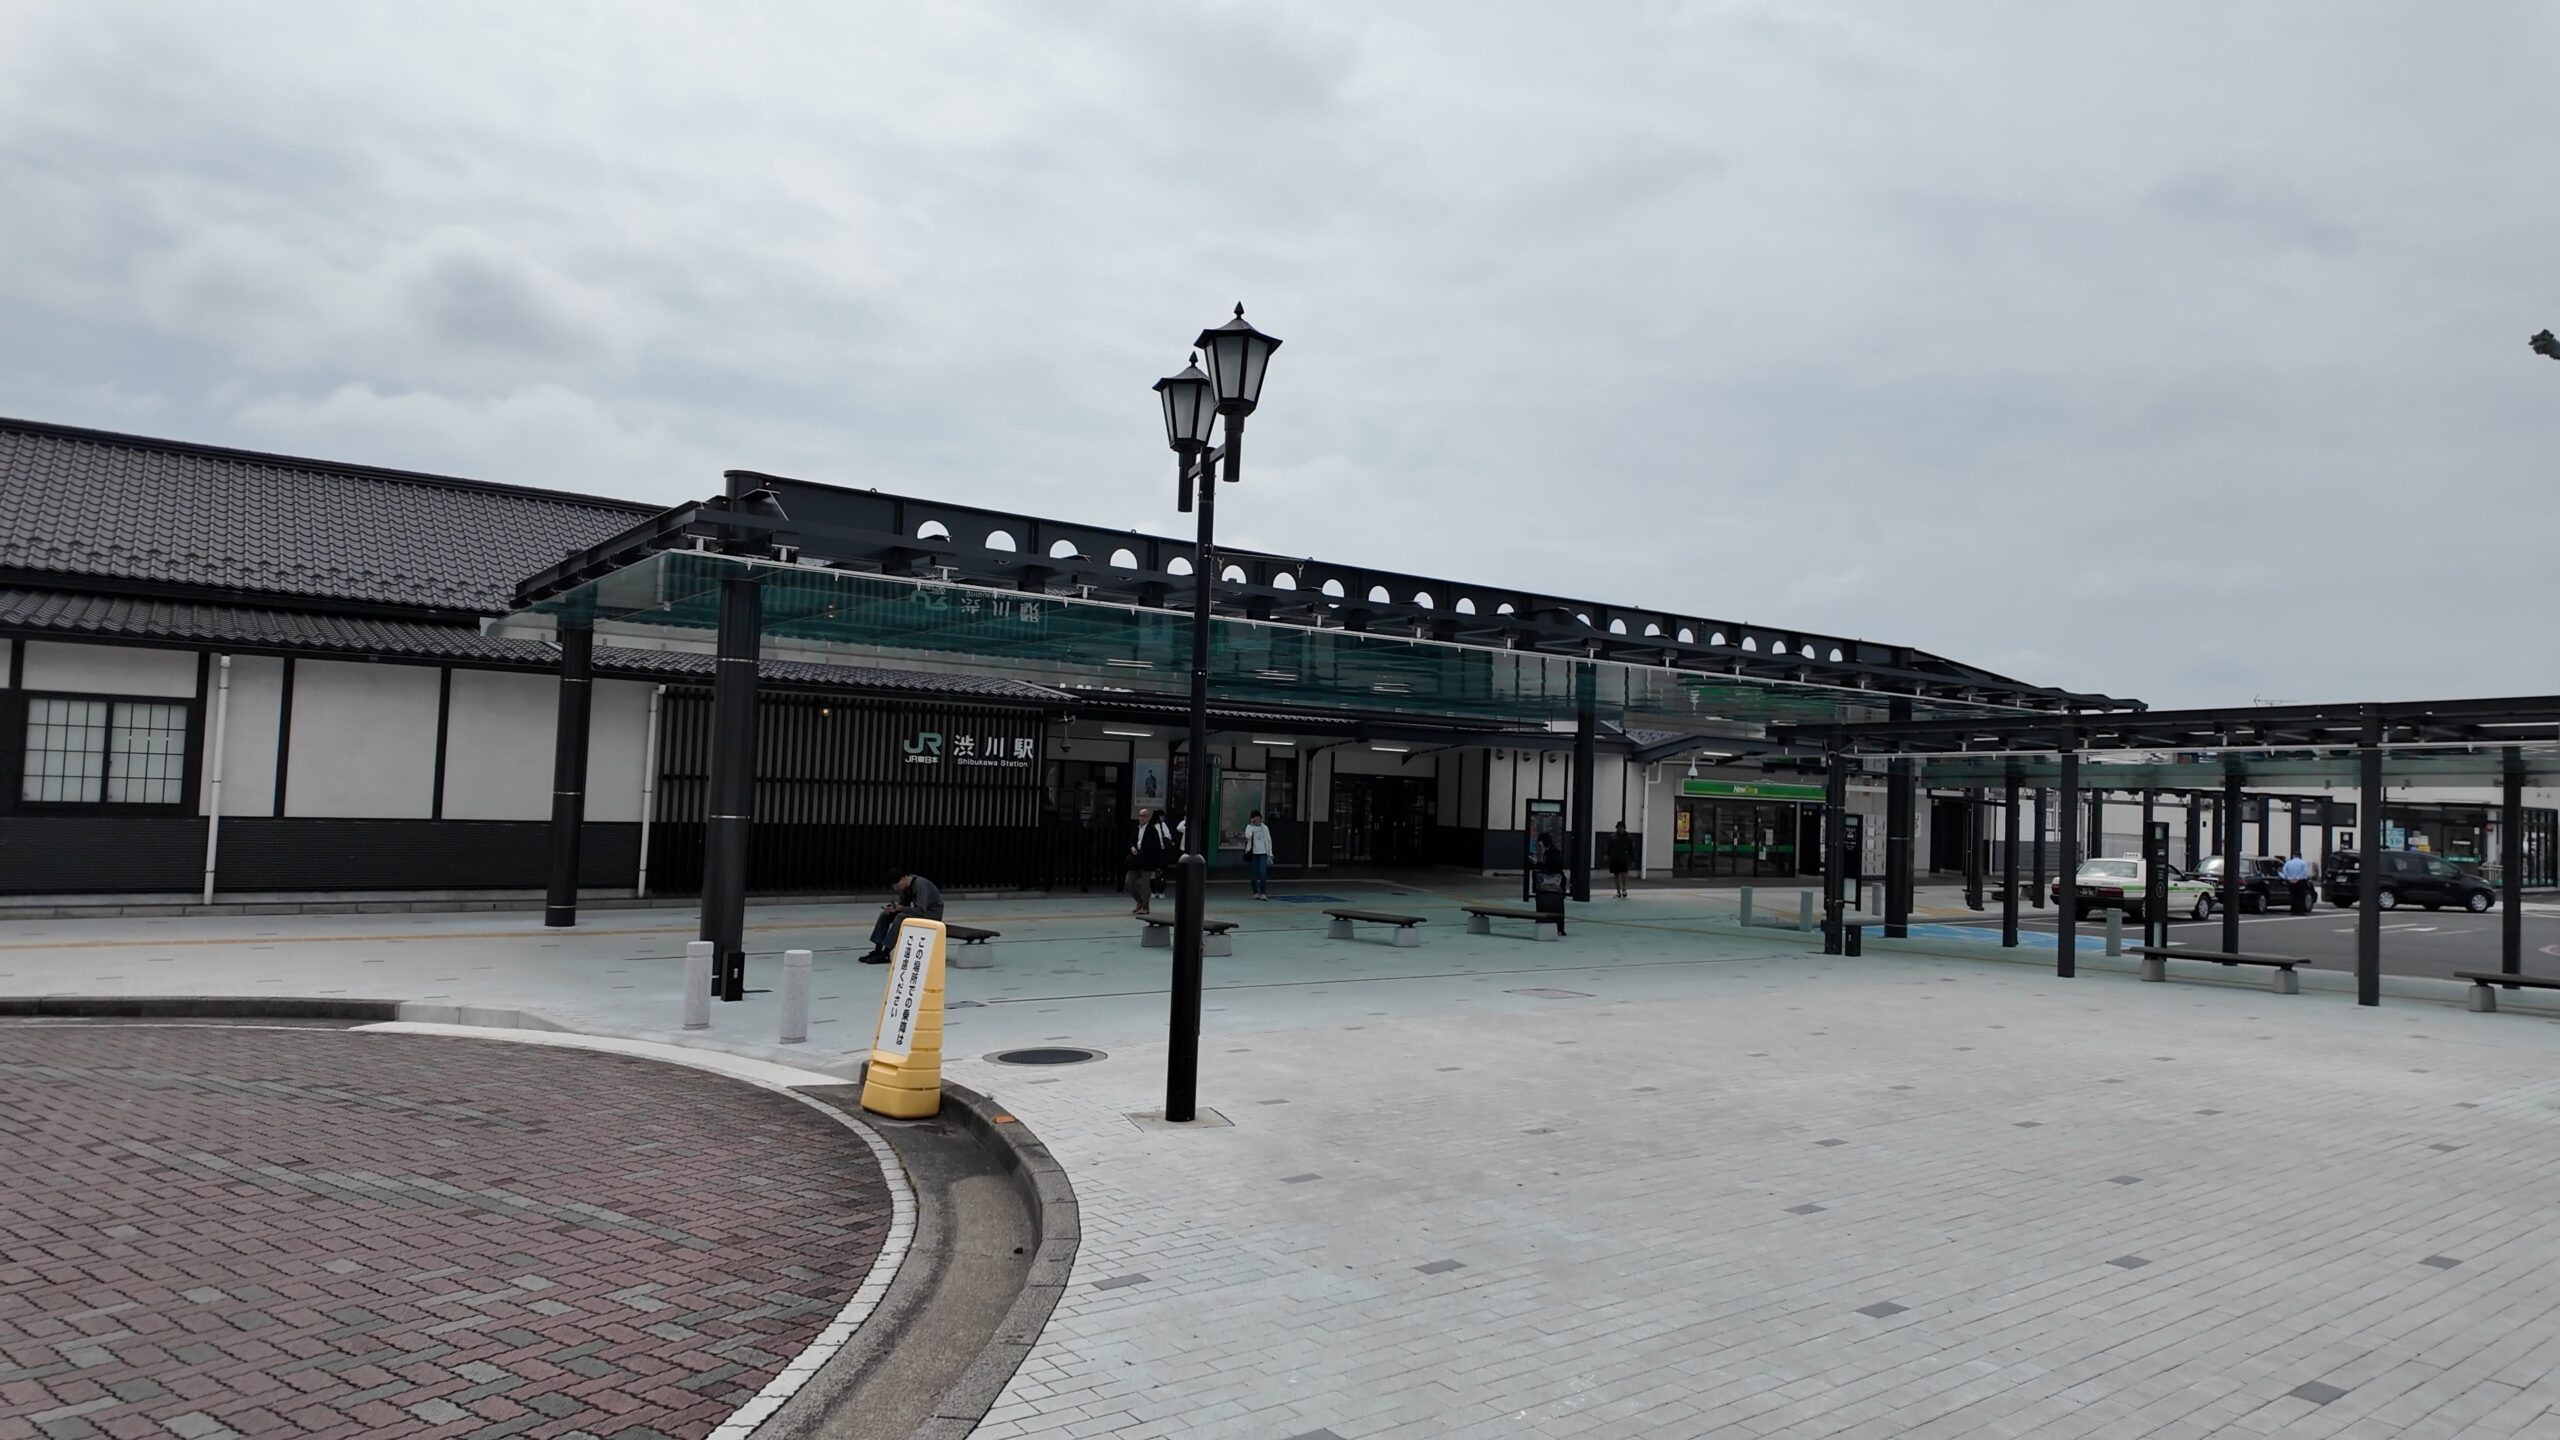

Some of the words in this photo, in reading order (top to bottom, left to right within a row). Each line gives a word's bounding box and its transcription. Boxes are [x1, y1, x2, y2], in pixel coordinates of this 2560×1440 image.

[903, 732, 942, 755] JR
[953, 734, 1034, 759] 渋川駅
[905, 755, 940, 764] JR東日本
[957, 757, 999, 767] Shibukawa
[1000, 759, 1028, 768] Station
[890, 935, 914, 1018] ご遠慮ください
